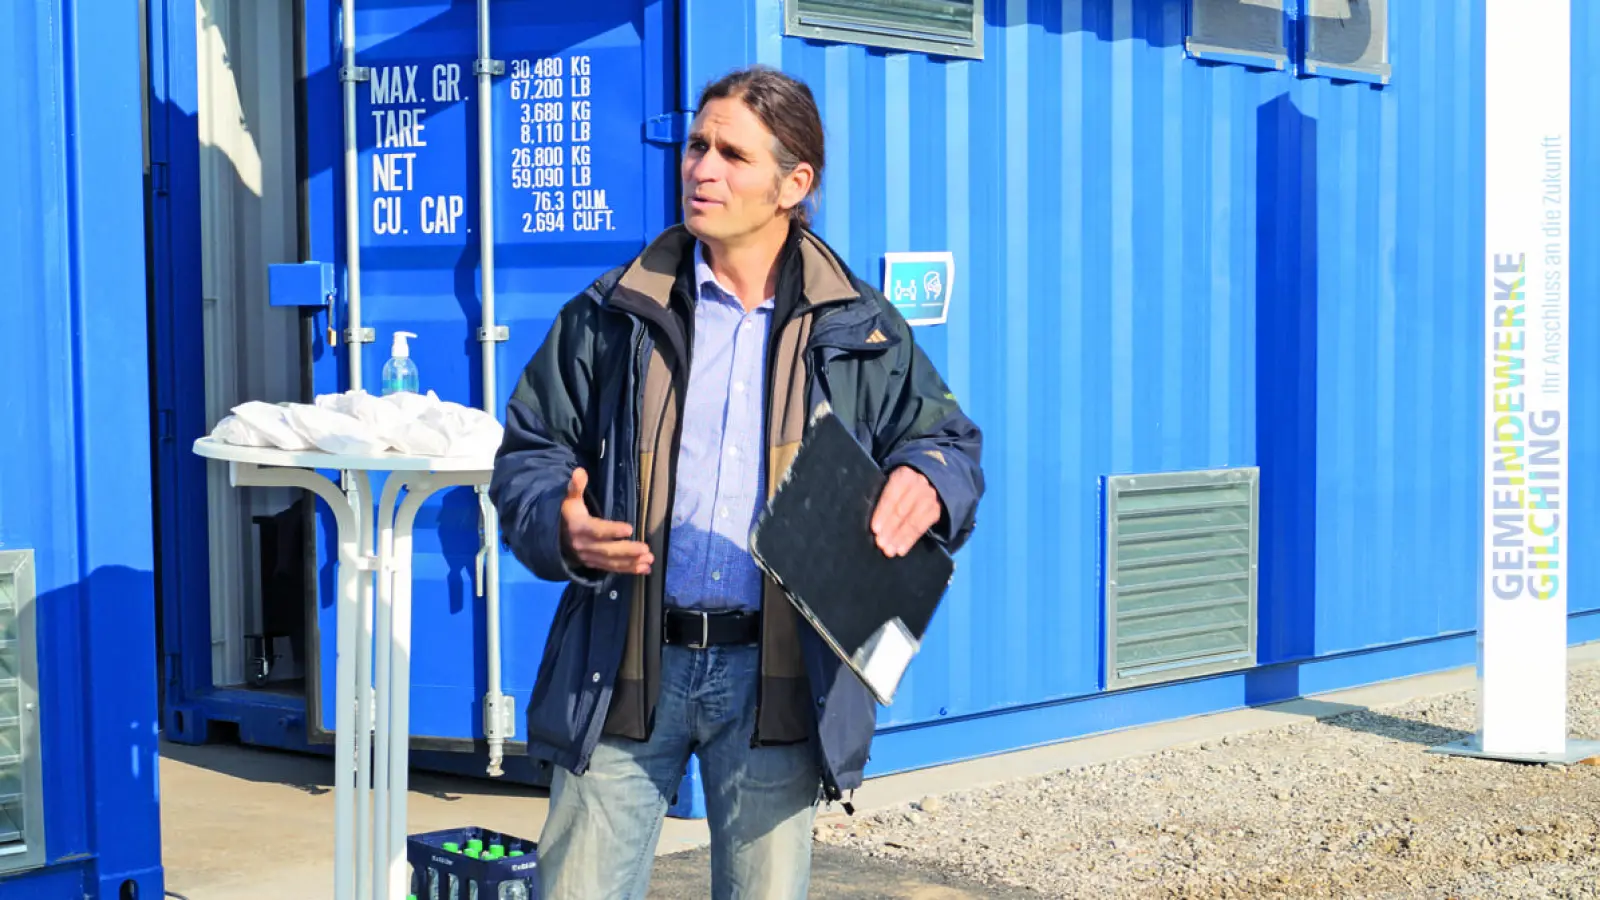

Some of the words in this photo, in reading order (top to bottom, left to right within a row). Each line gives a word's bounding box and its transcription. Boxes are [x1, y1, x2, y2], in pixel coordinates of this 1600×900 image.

[511, 57, 562, 79] 30,480
[570, 55, 591, 76] KG
[370, 66, 426, 105] MAX.
[432, 63, 469, 102] GR.
[511, 78, 562, 100] 67,200
[571, 77, 591, 98] LB
[520, 102, 562, 123] 3,680
[571, 101, 591, 121] KG
[372, 109, 427, 148] TARE
[520, 123, 562, 145] 8,110
[571, 122, 591, 143] LB
[511, 147, 563, 168] 26,800
[571, 145, 591, 166] KG
[372, 153, 416, 192] NET
[512, 168, 563, 189] 59,090
[571, 167, 591, 187] LB
[1542, 134, 1562, 205] Zukunft
[532, 191, 564, 212] 76.3
[373, 197, 408, 235] CU.
[420, 195, 471, 234] CAP.
[522, 211, 564, 233] 2,694
[1542, 210, 1562, 237] die
[1546, 243, 1562, 265] an
[1541, 271, 1562, 365] Anschluss
[1542, 371, 1561, 394] Ihr
[1492, 252, 1526, 600] GEMEINDEWERKE
[1528, 409, 1561, 600] GILCHING
